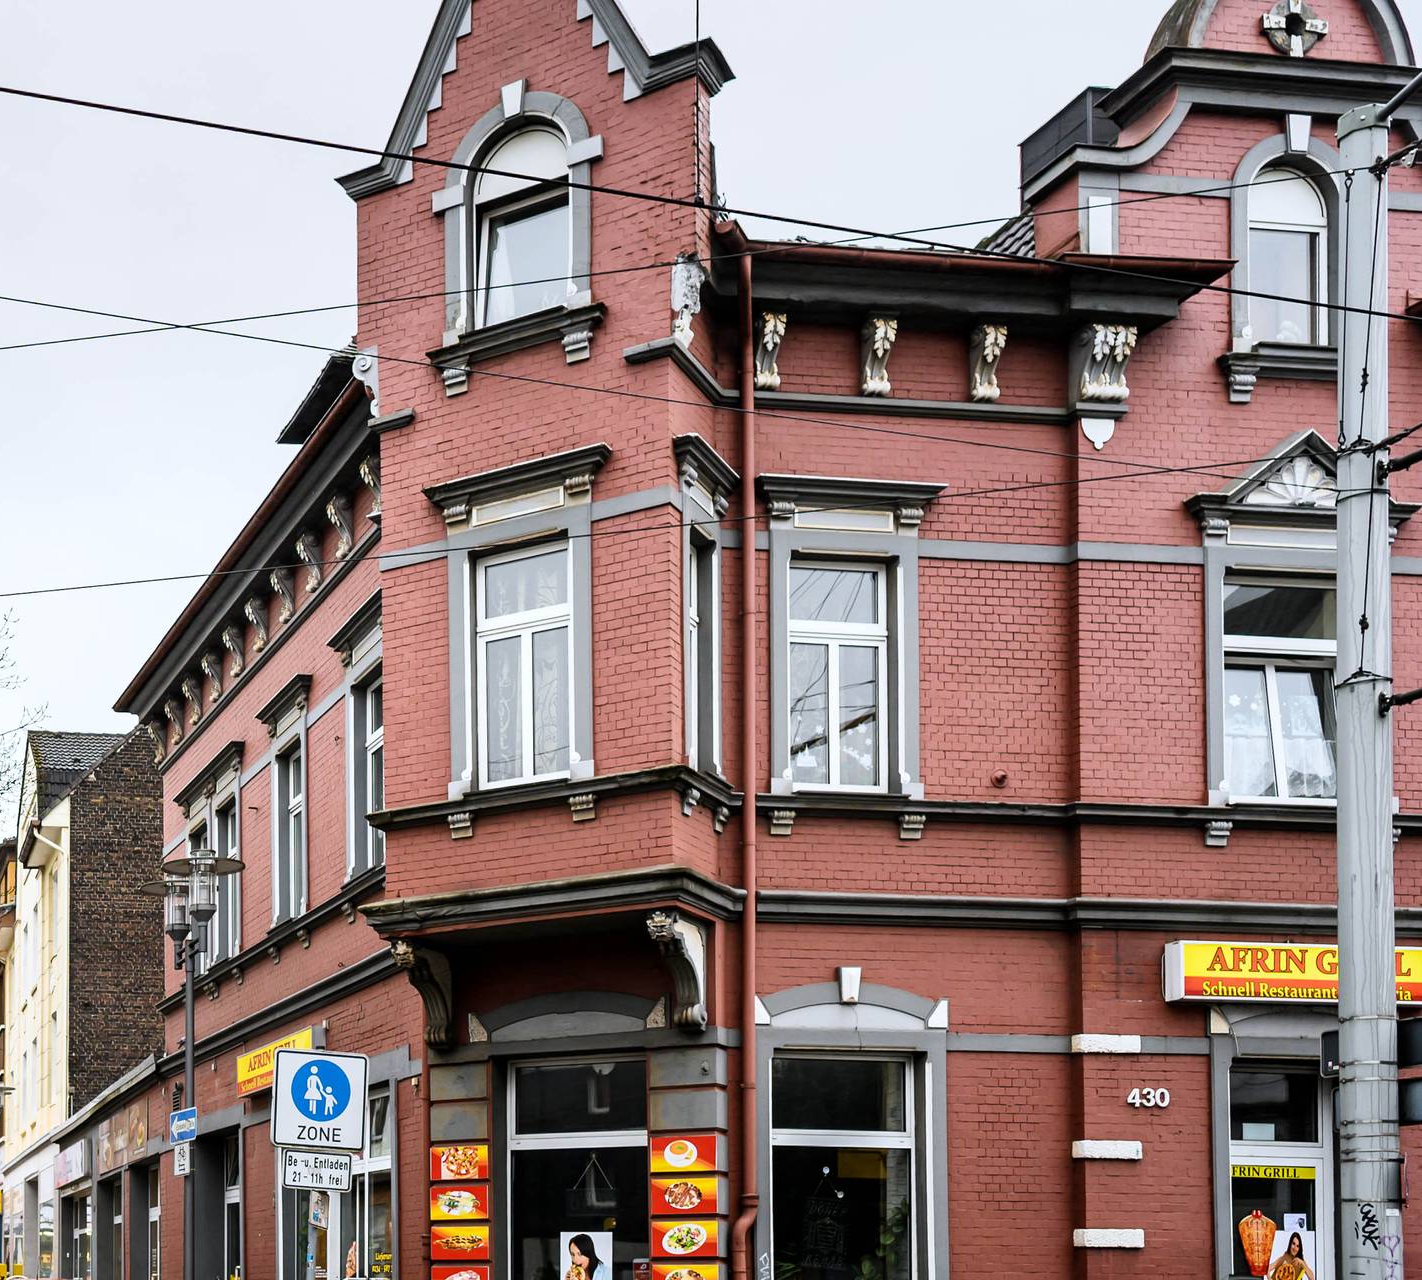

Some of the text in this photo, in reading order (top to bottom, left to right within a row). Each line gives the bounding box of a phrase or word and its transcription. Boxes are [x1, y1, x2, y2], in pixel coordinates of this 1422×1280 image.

[1207, 946, 1308, 974] AFRIN
[1202, 980, 1338, 1000] Schnell Restaurant
[247, 1049, 272, 1073] AFRIN
[1127, 1087, 1170, 1108] 430
[297, 1125, 342, 1143] ZONE
[314, 1157, 349, 1171] Entladen
[1231, 1166, 1300, 1178] FRIN GRILL
[292, 1171, 301, 1183] 21
[310, 1172, 324, 1185] 11h
[328, 1173, 343, 1186] frei
